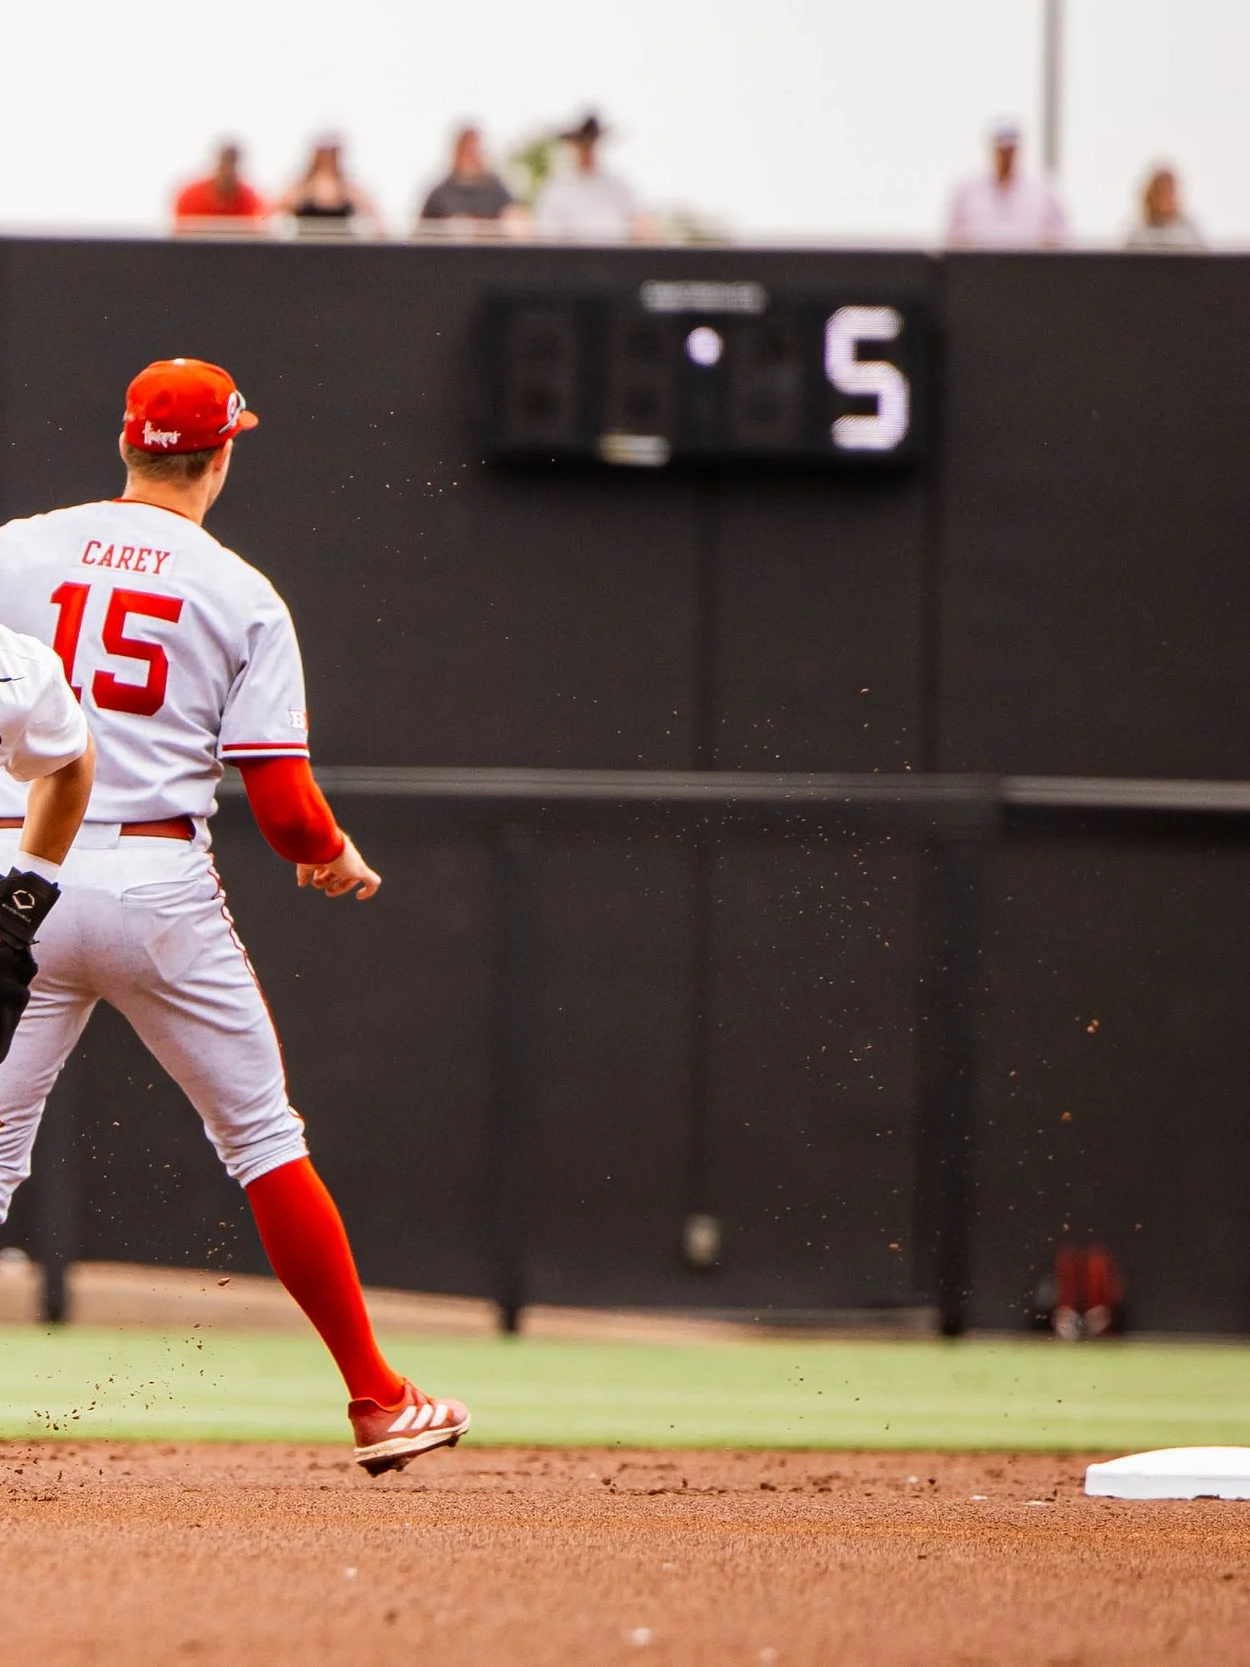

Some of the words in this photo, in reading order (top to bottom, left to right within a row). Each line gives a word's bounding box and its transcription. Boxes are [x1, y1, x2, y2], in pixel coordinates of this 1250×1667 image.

[825, 306, 909, 451] 5
[81, 540, 170, 575] CAREY
[50, 581, 184, 717] 15
